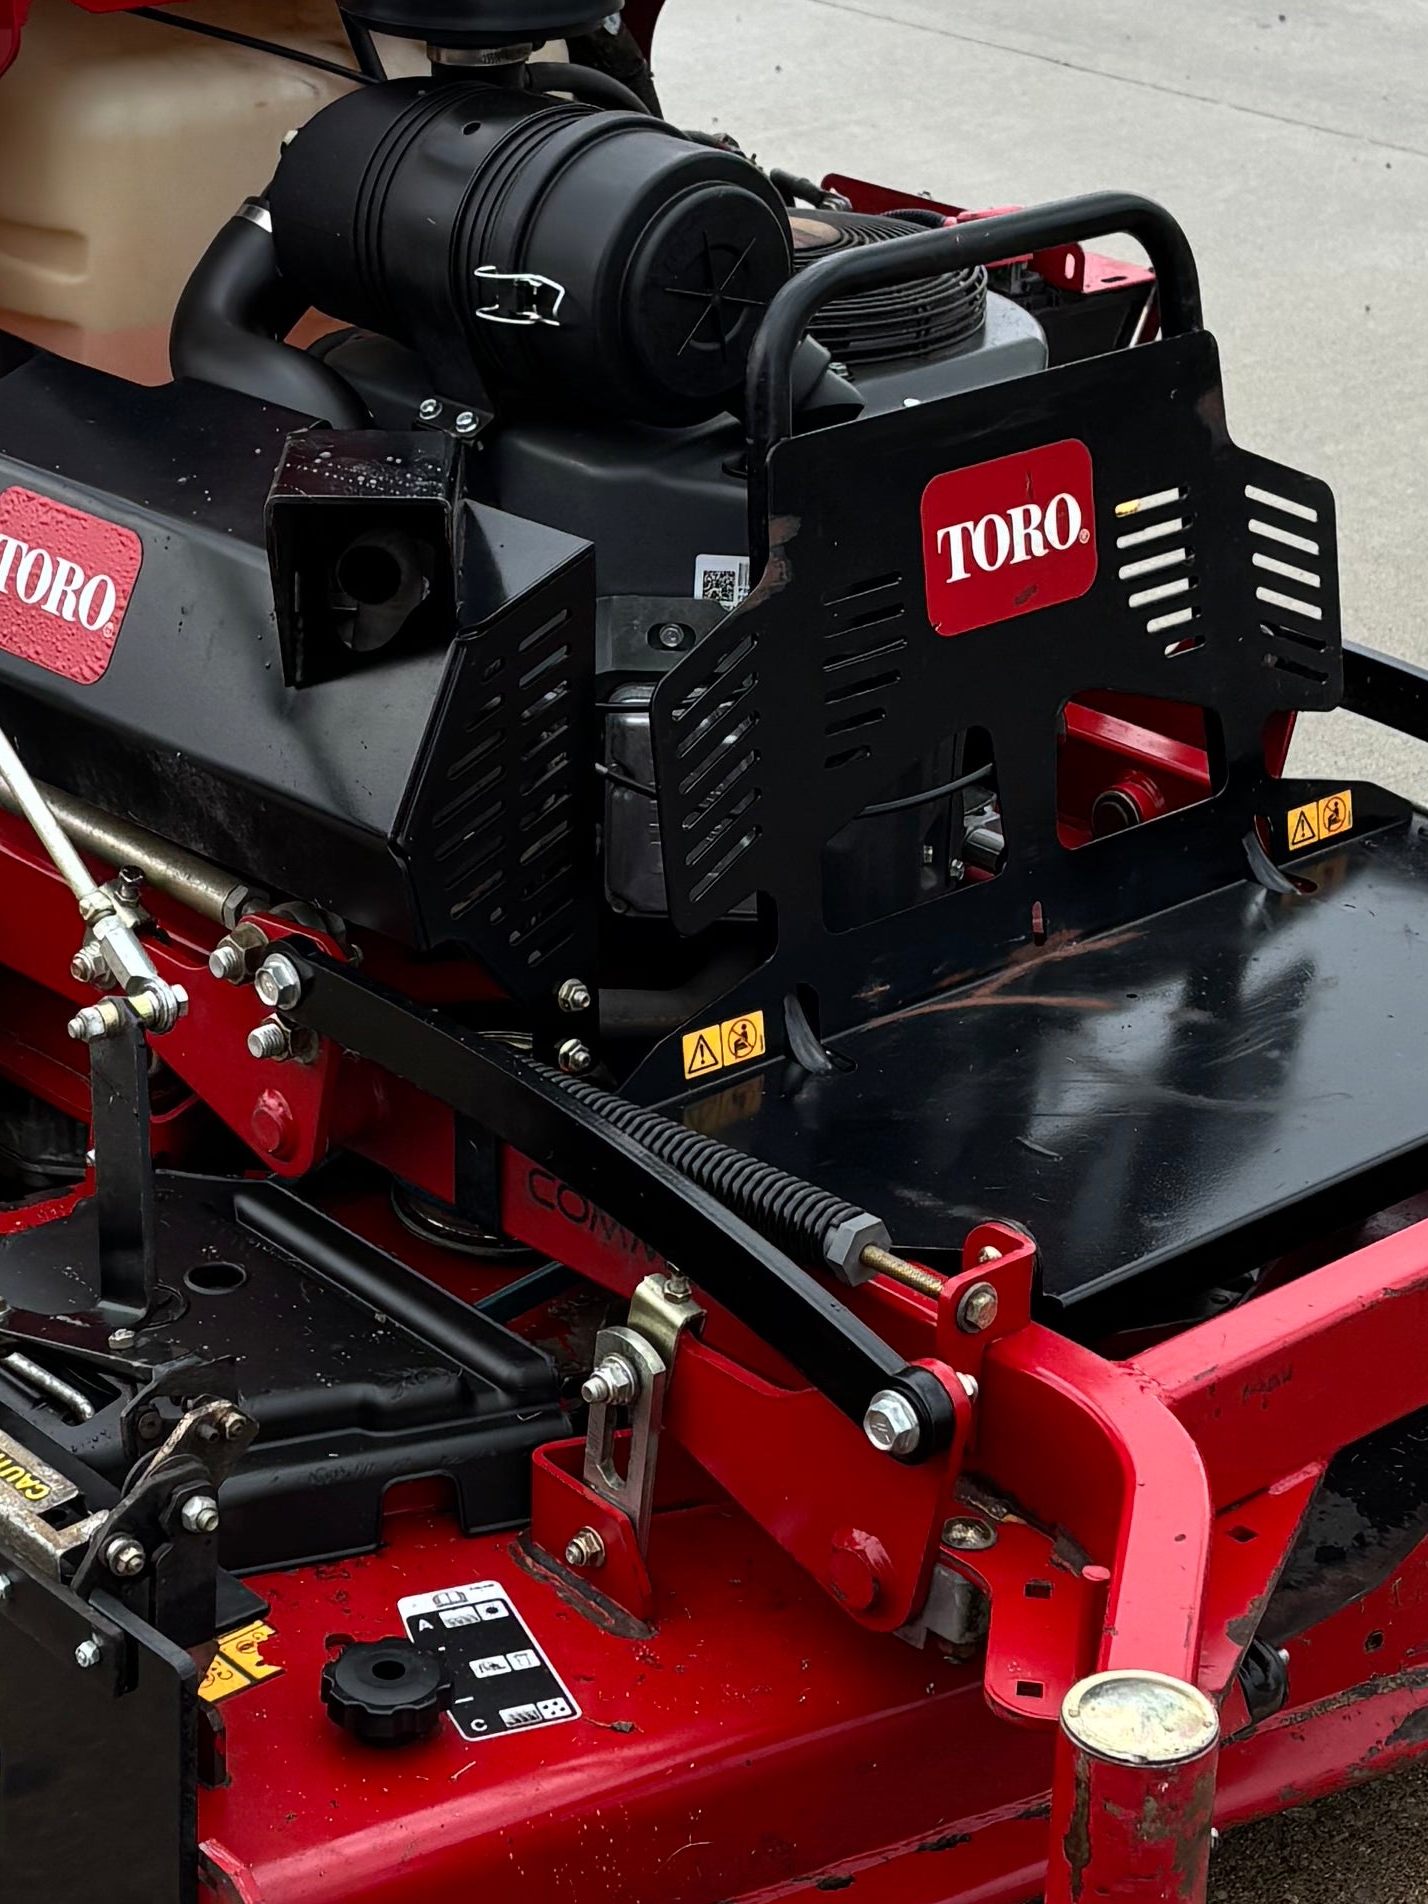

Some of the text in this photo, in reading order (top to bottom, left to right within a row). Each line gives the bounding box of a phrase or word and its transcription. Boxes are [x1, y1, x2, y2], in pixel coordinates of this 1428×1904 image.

[936, 492, 1083, 583] TORO
[419, 1619, 434, 1632] A
[470, 1718, 488, 1732] C
